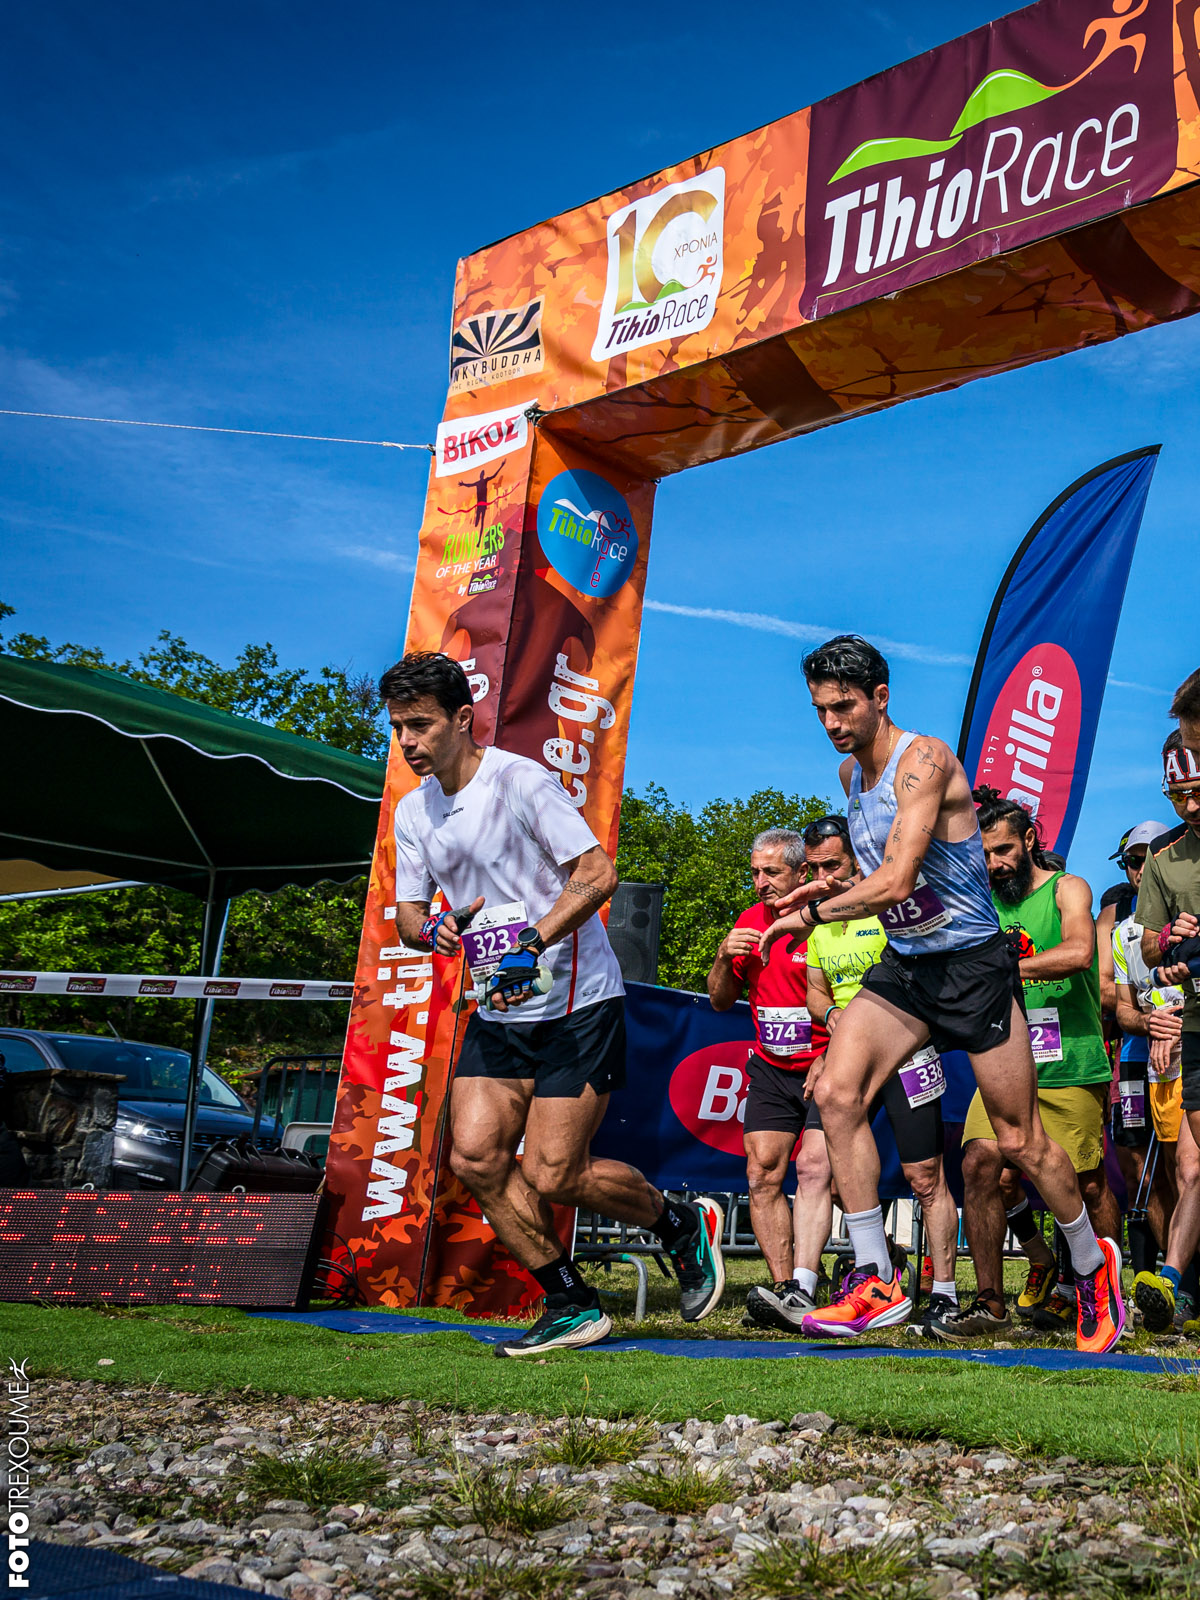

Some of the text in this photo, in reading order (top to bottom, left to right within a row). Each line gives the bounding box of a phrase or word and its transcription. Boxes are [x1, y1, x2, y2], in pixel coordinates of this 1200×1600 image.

[822, 102, 1142, 288] TihioRace
[605, 292, 710, 350] TihioRace
[452, 348, 542, 383] NKYBUDDHA
[439, 522, 506, 566] RUNNERS
[435, 554, 498, 579] OF THE YEAR
[457, 584, 467, 596] by
[983, 735, 1000, 774] 1877
[1005, 678, 1064, 824] arilla
[472, 928, 512, 959] 323
[818, 950, 877, 972] TUSCANY
[764, 1023, 798, 1041] 374
[915, 1060, 943, 1087] 338
